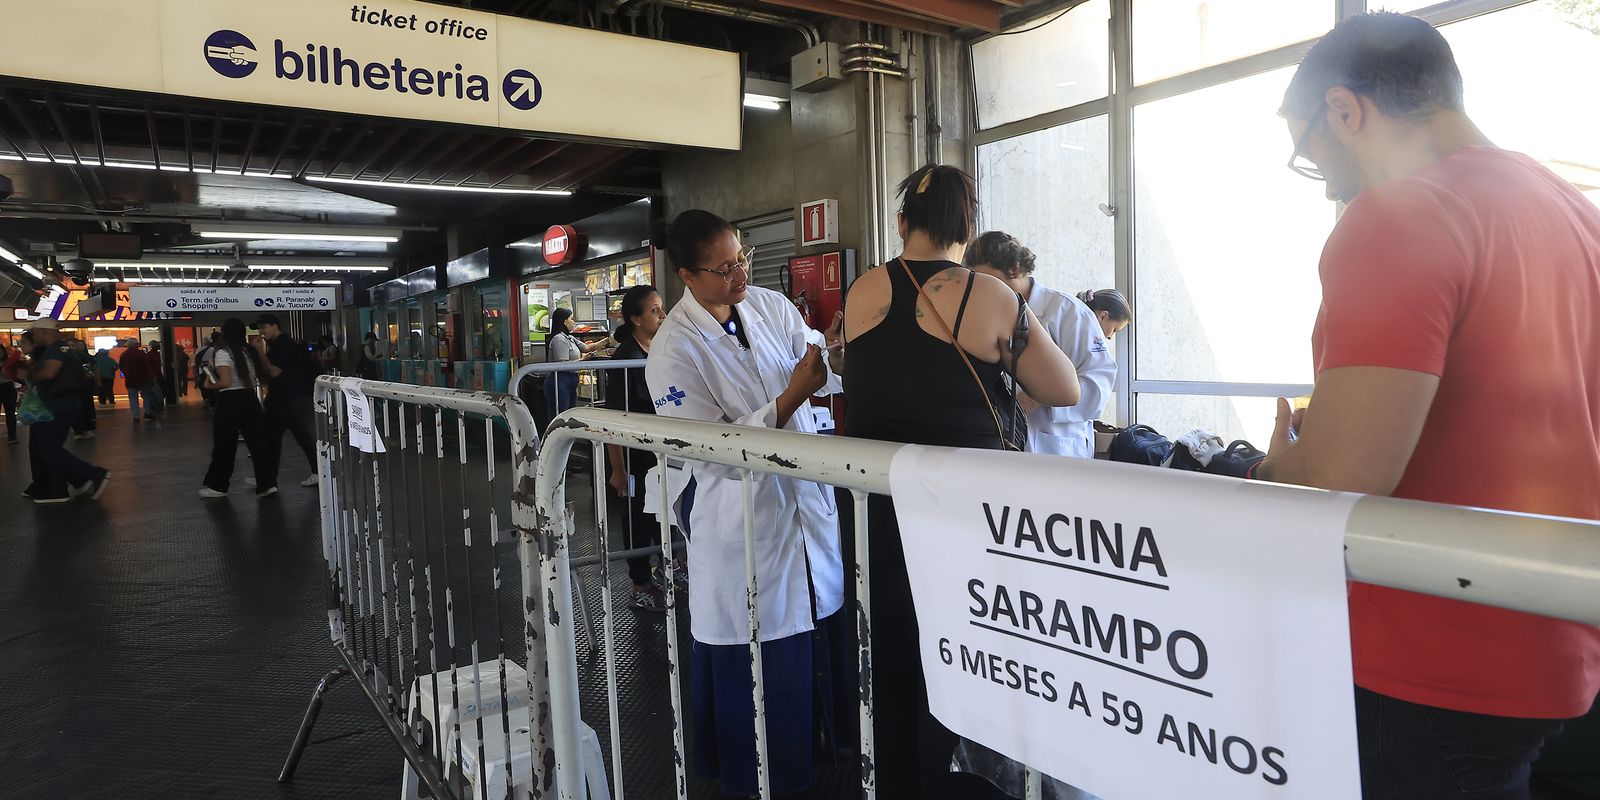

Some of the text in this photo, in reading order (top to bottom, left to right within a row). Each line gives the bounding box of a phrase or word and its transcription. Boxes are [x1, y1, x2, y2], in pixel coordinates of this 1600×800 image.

[350, 5, 488, 41] ticket office
[274, 39, 490, 102] bilheteria
[655, 396, 667, 409] SUS
[982, 502, 1168, 578] VACINA
[967, 578, 1209, 681] SARAMPO
[938, 637, 1289, 786] 6 MESES A 59 ANOS
